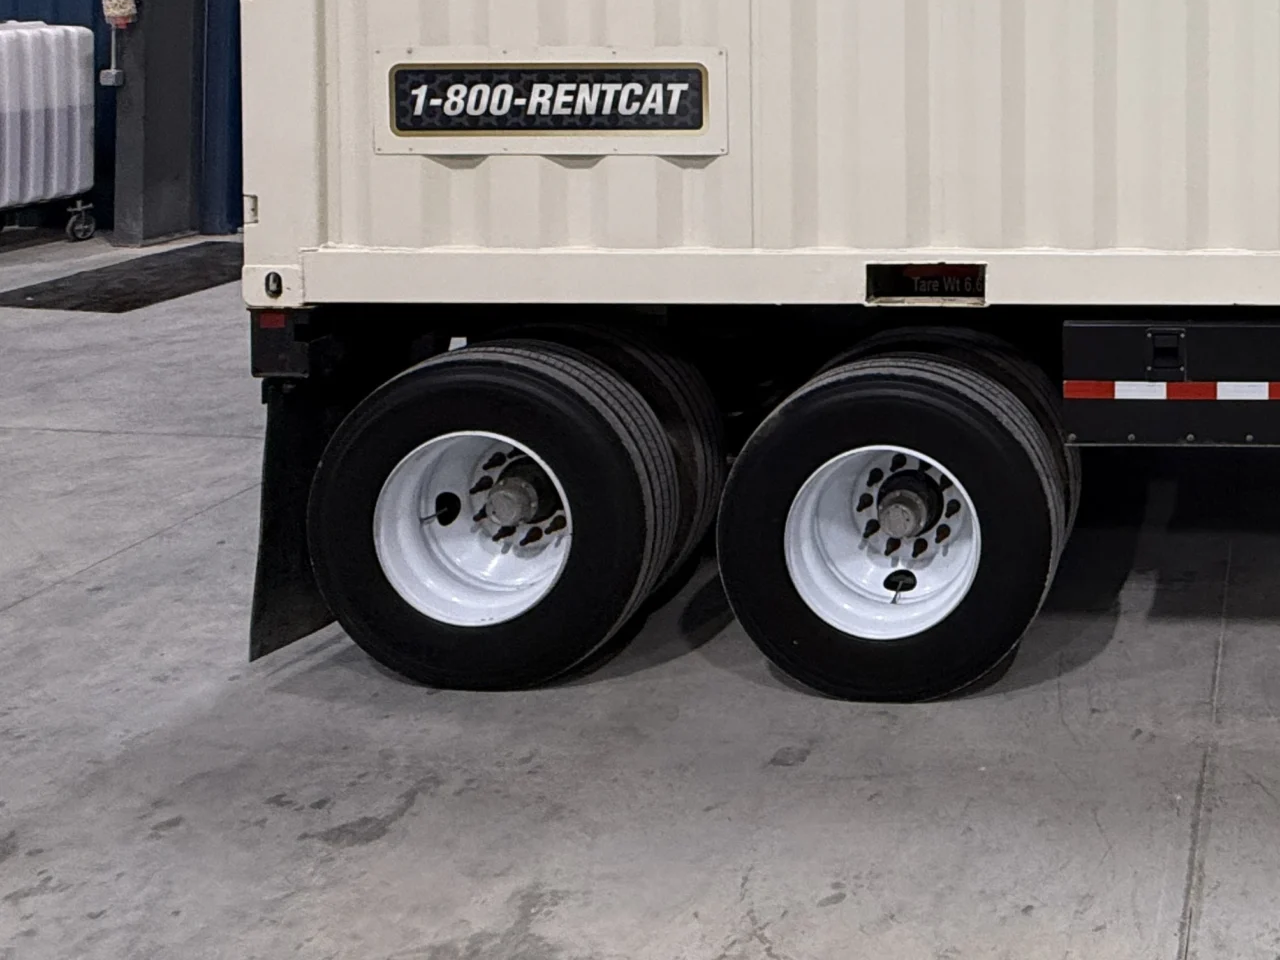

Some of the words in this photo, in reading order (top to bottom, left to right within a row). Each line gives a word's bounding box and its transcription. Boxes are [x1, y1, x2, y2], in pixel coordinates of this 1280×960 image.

[411, 83, 689, 116] 1-800-RENTCAT
[912, 276, 939, 292] Tare
[943, 276, 960, 292] Wt
